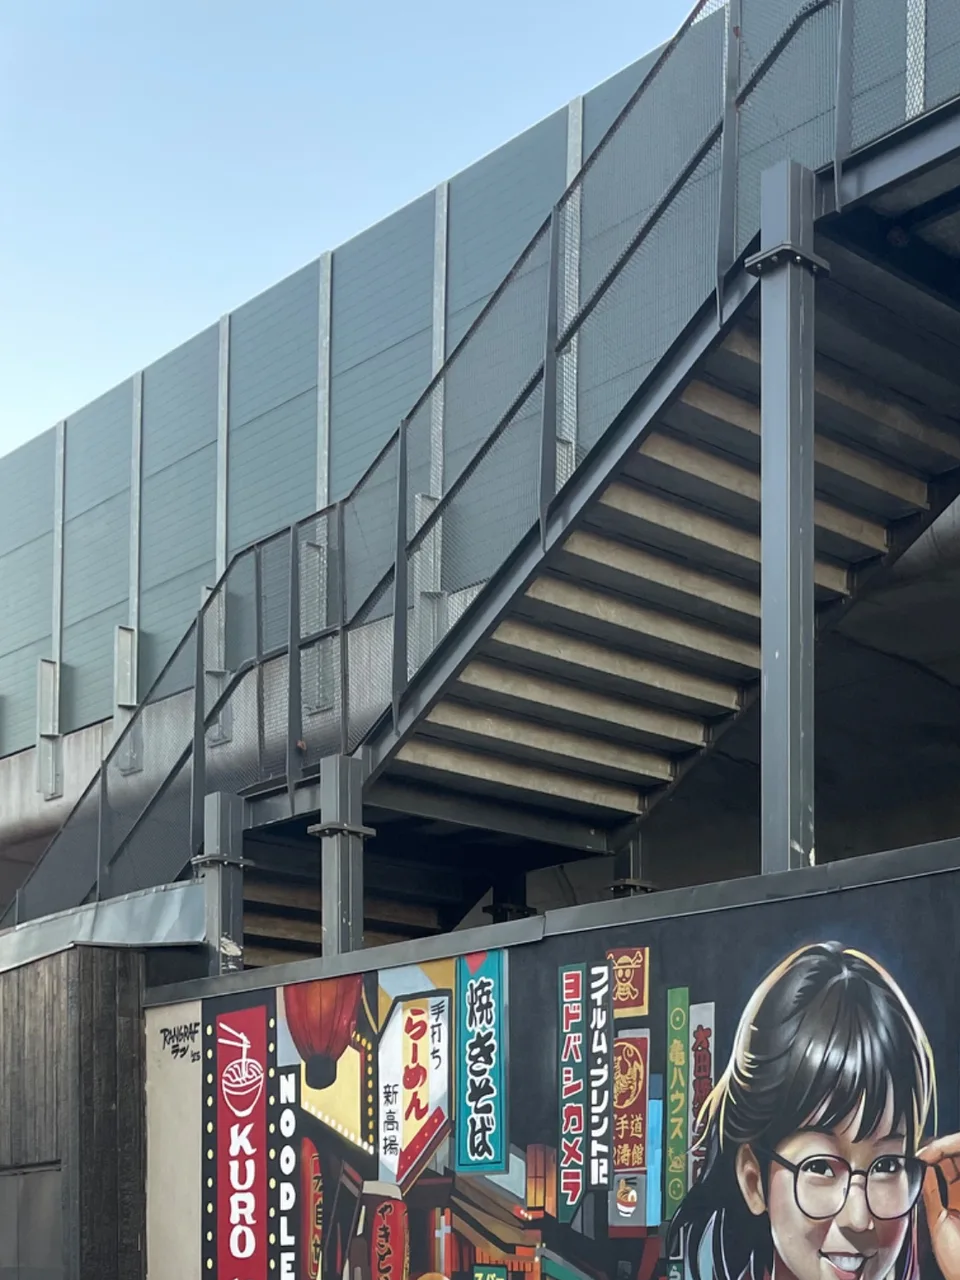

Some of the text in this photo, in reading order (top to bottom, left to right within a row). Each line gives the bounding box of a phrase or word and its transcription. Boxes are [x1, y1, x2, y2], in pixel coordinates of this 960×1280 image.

[402, 1007, 430, 1122] らーめん
[430, 999, 446, 1070] 手打ち
[465, 976, 498, 1162] 焼きそば
[228, 1122, 257, 1260] KURO
